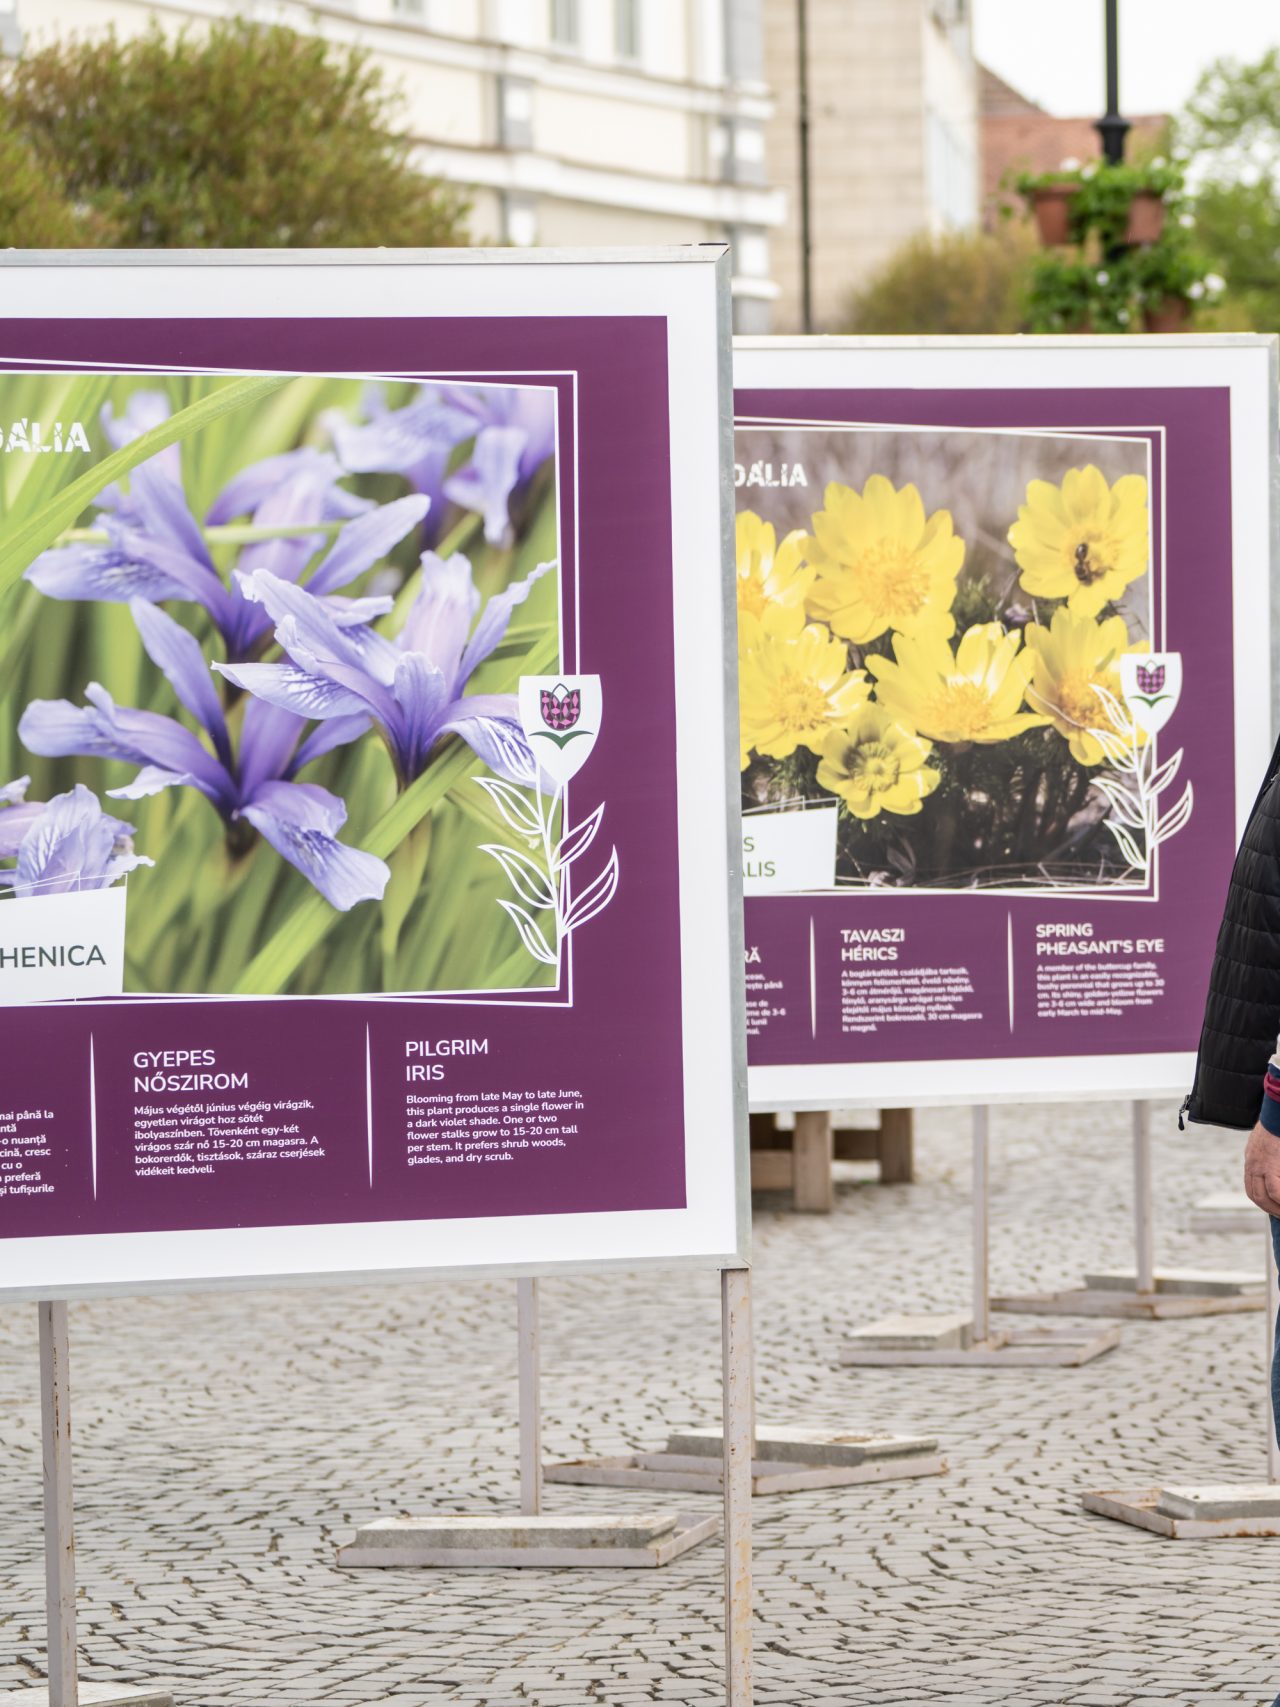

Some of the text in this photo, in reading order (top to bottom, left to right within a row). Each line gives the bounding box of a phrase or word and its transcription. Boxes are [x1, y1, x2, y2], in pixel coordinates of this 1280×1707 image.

[0, 418, 91, 453] ÁLIA
[742, 861, 776, 877] LIS
[840, 928, 905, 943] TAVASZI
[1036, 922, 1093, 938] SPRING
[841, 944, 898, 961] HÉRICS
[1036, 938, 1164, 956] PHEASANT'S EYE
[0, 944, 107, 969] HENICA
[406, 1038, 488, 1057] PILGRIM
[133, 1049, 216, 1068] GYEPES
[406, 1064, 445, 1081] IRIS
[134, 1071, 248, 1093] NŐSZIROM
[406, 1089, 582, 1104] Blooming from late May to late June,
[16, 1110, 42, 1122] până
[44, 1110, 54, 1119] la
[134, 1099, 314, 1117] Május végétől június végéig virágzik,
[406, 1107, 425, 1116] this
[427, 1106, 453, 1117] plant
[455, 1104, 499, 1116] produces
[510, 1102, 539, 1113] single
[541, 1102, 573, 1111] flower
[575, 1100, 584, 1109] in
[134, 1113, 264, 1129] egyetlen virágot hoz sötét
[415, 1118, 437, 1128] dark
[439, 1117, 467, 1127] violet
[469, 1116, 501, 1126] shade.
[503, 1115, 523, 1124] One
[538, 1115, 557, 1123] two
[134, 1124, 299, 1141] ibolyaszínben. Tövenként egy-két
[407, 1125, 578, 1140] flower stalks grow to 15-20 cm tall
[134, 1142, 172, 1153] virágos
[174, 1140, 195, 1150] szár
[197, 1139, 210, 1149] nő
[213, 1138, 243, 1149] 15-20
[263, 1138, 308, 1148] magasra.
[310, 1135, 319, 1145] A
[407, 1138, 566, 1154] per stem. It prefers shrub woods,
[24, 1148, 51, 1157] cresc
[135, 1147, 325, 1164] bokorerdők, tisztások, száraz cserjések
[407, 1152, 514, 1166] glades, and dry scrub.
[4, 1171, 41, 1184] preferă
[135, 1164, 215, 1176] vidékeit kedveli.
